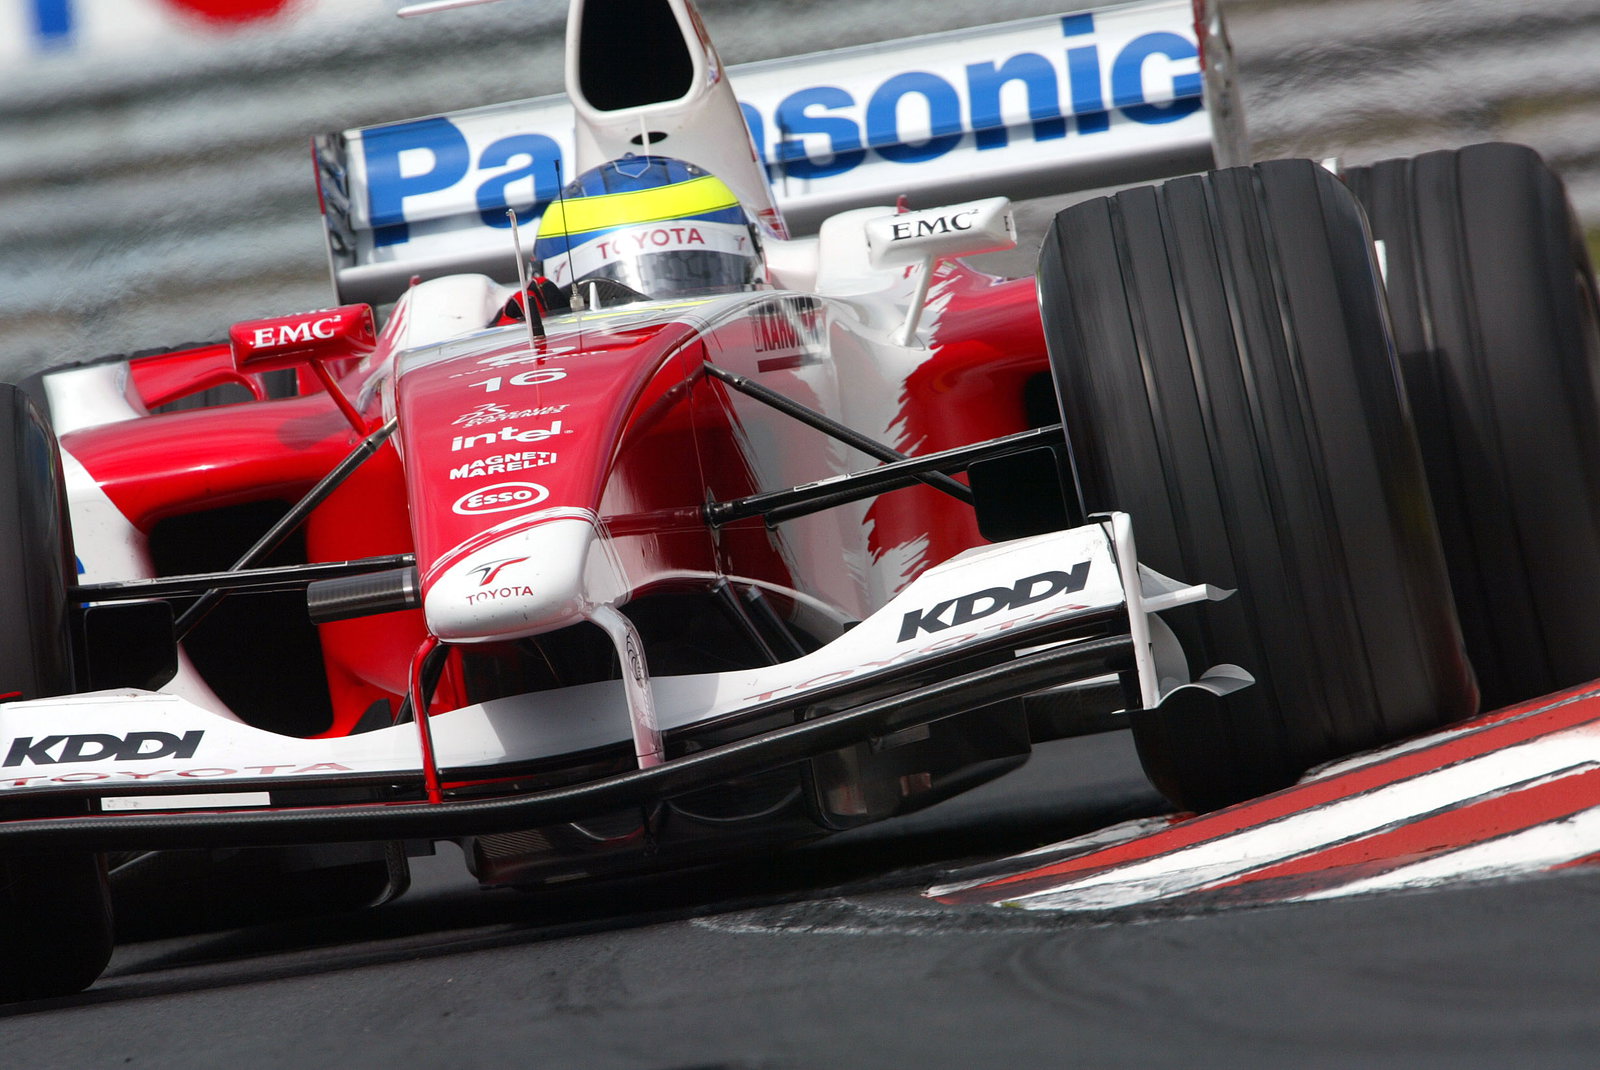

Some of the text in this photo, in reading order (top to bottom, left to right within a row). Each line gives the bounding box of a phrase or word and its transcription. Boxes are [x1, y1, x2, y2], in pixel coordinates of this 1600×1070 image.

[362, 13, 1205, 247] Pasonic
[468, 368, 567, 392] 16
[449, 458, 557, 480] MARELLI
[450, 452, 557, 474] MAGNETI
[466, 586, 534, 606] TOYOTA
[897, 560, 1091, 643] KDDI
[2, 730, 206, 767] KDDI
